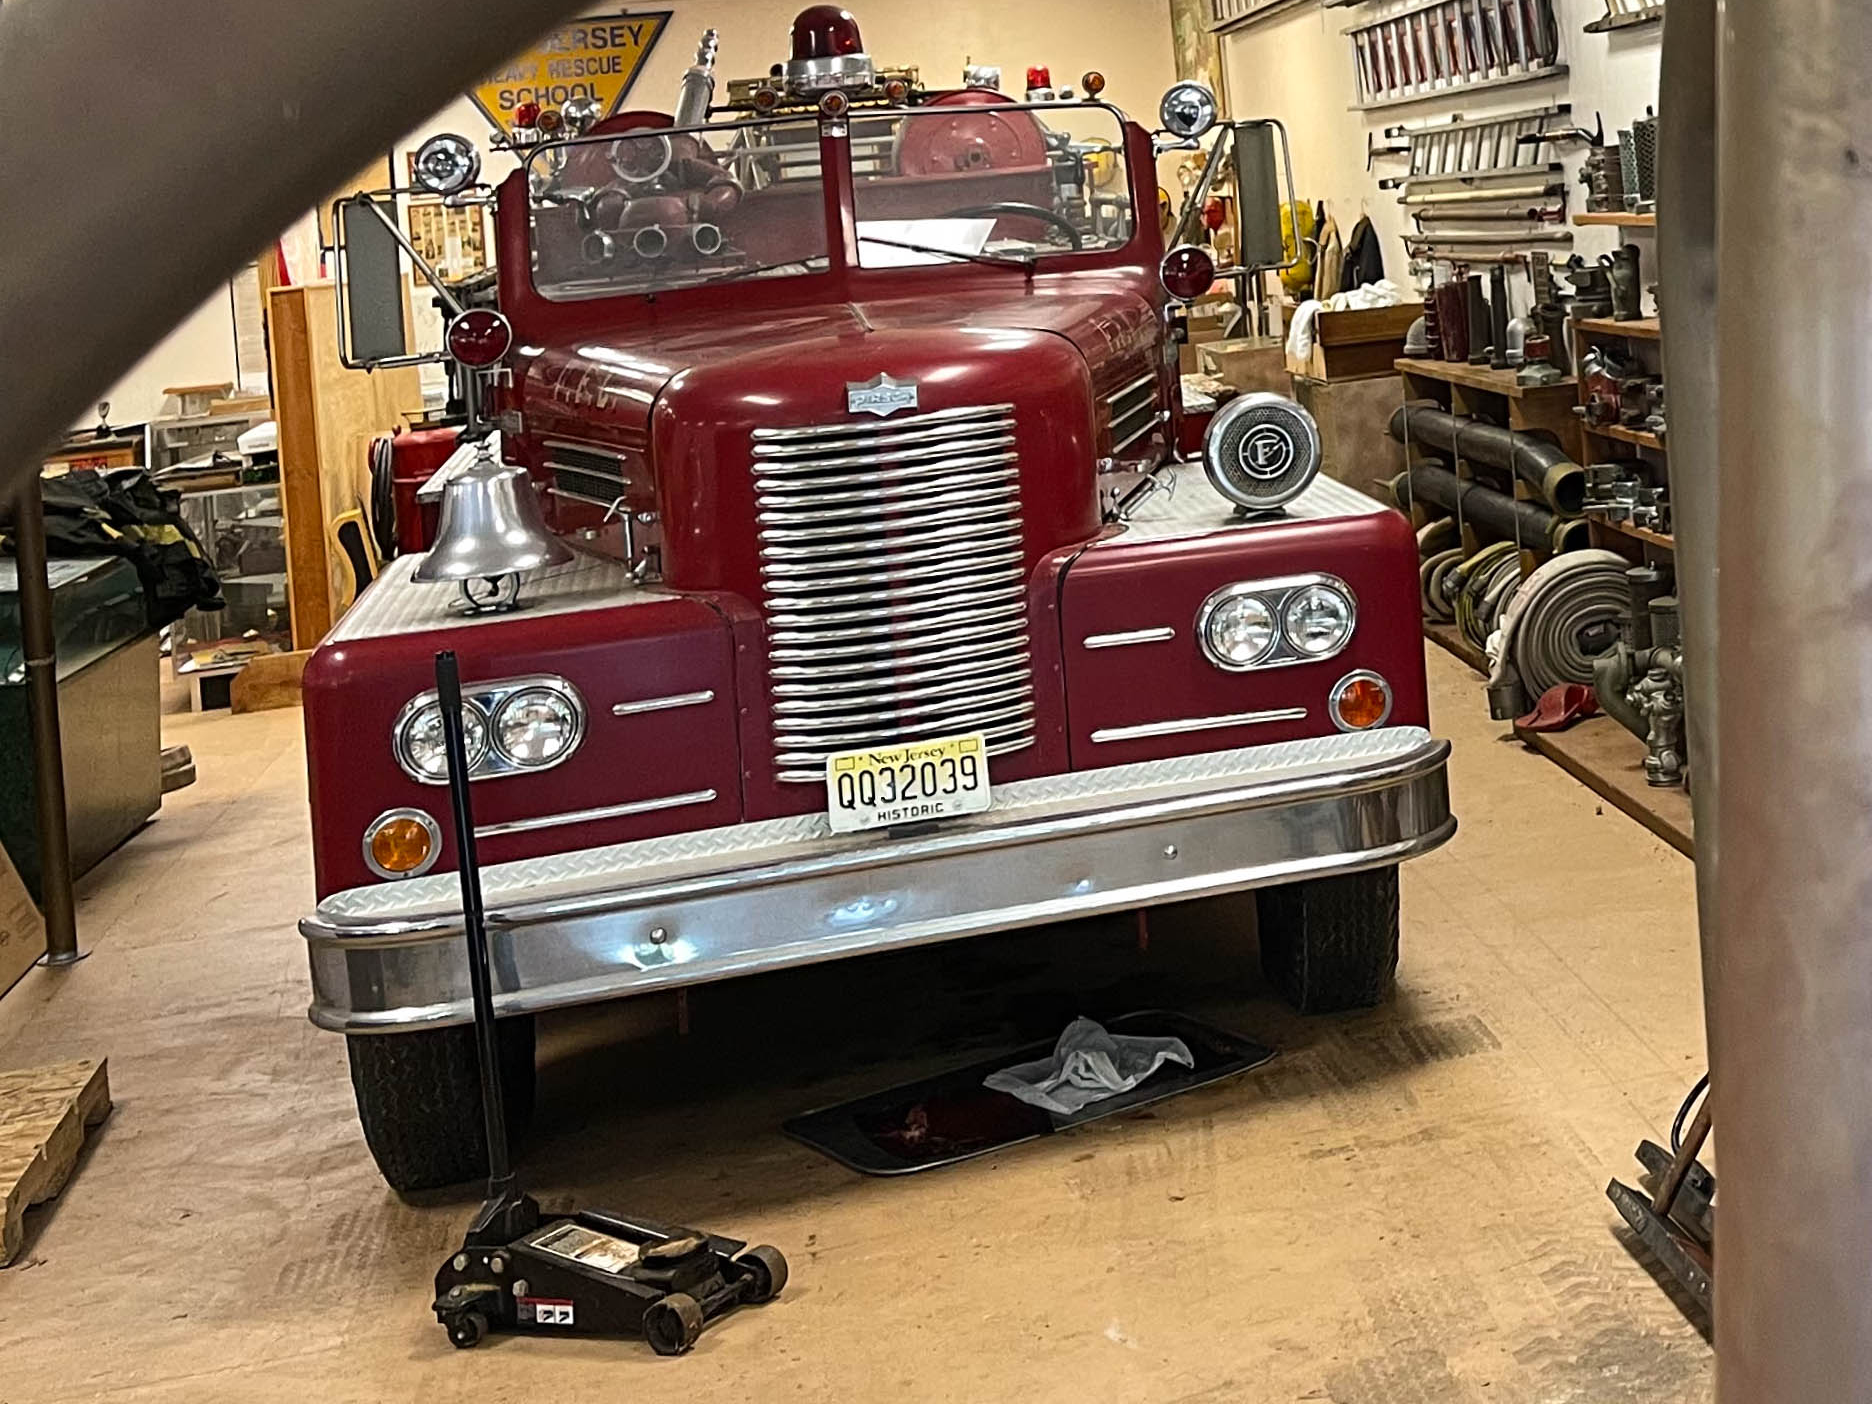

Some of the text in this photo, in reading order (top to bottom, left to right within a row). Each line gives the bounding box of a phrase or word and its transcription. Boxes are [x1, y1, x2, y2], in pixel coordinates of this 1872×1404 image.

[547, 55, 624, 80] RESCUE
[498, 82, 604, 111] SCHOOL
[868, 747, 946, 766] New Jersey
[837, 755, 979, 811] QQ32039
[877, 802, 945, 822] HISTORIC
